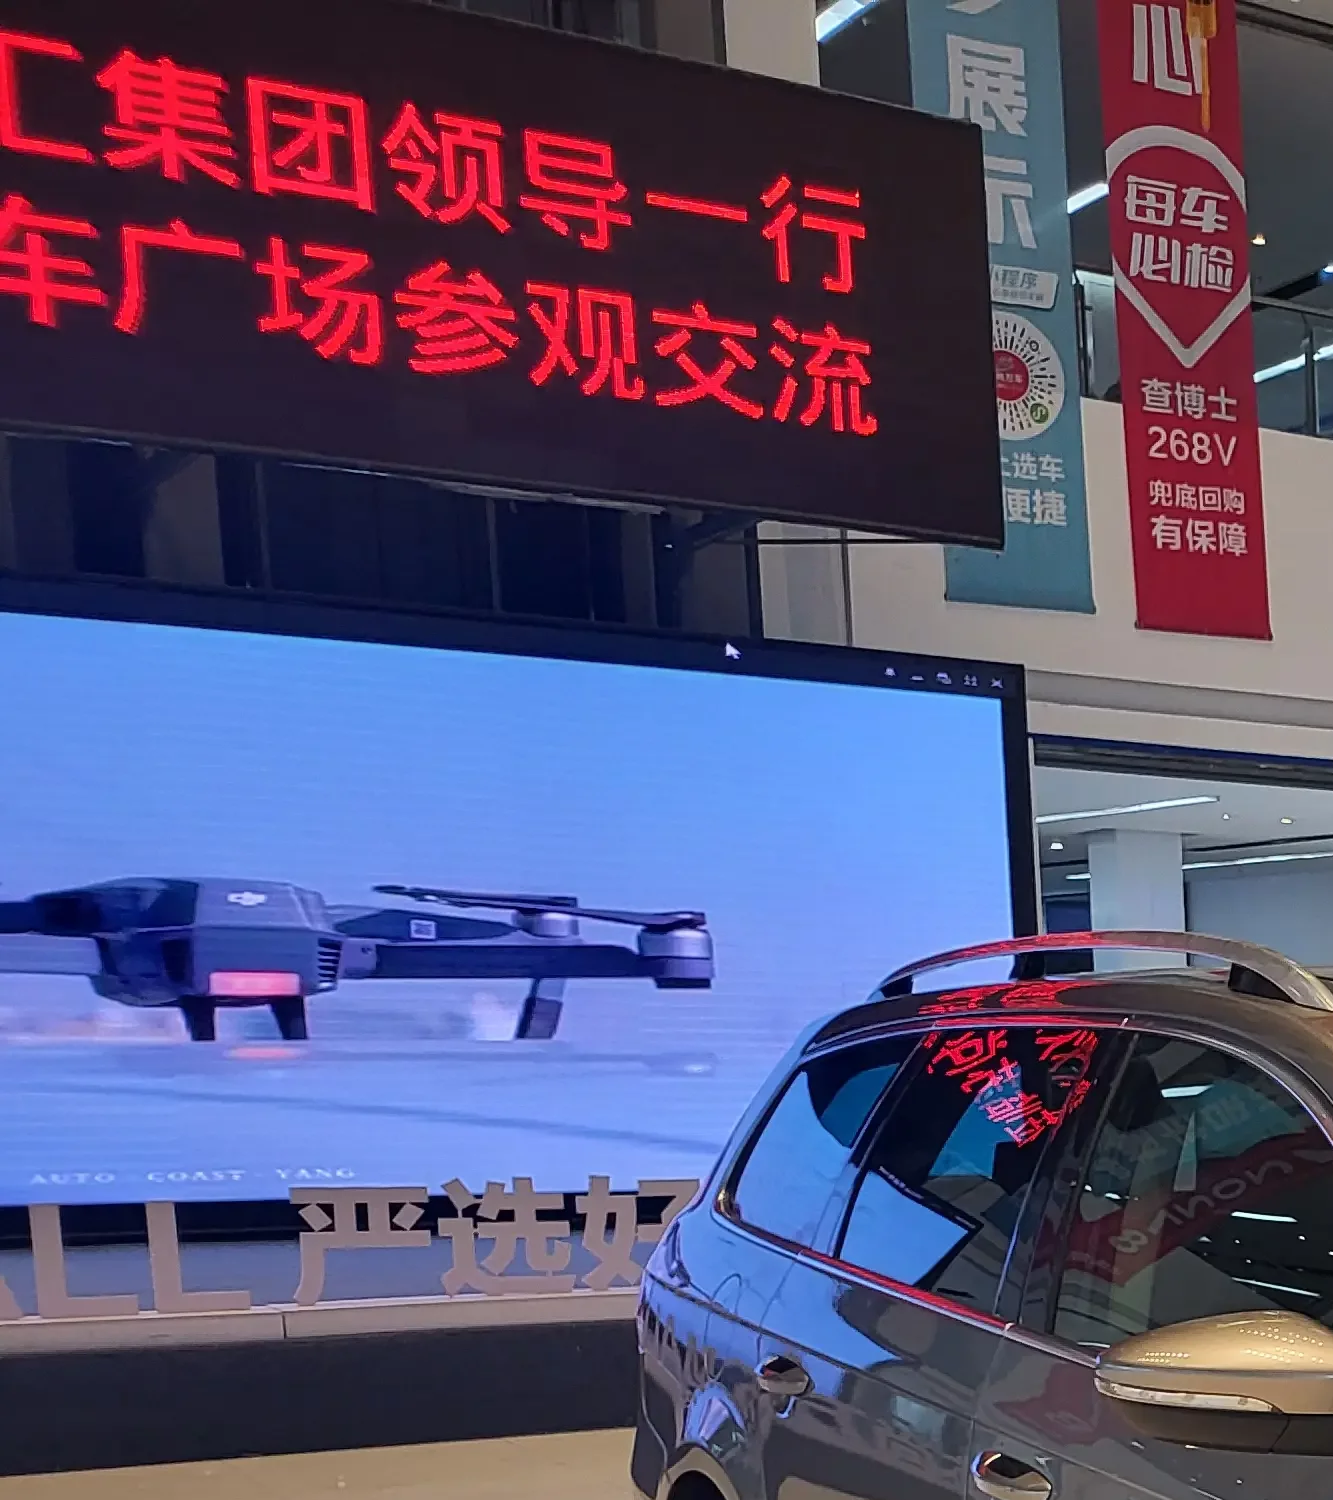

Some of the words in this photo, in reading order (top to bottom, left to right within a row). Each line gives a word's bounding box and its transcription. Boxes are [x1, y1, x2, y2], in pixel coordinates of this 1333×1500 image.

[1129, 232, 1233, 293] 必检
[0, 194, 878, 436] 车广场参观交流
[1141, 378, 1238, 423] 查博士
[1147, 425, 1237, 467] 268V
[1149, 479, 1245, 515] 兜底回购
[1151, 514, 1248, 556] 有保障
[30, 1172, 116, 1185] AUTO
[0, 1202, 250, 1320] LL
